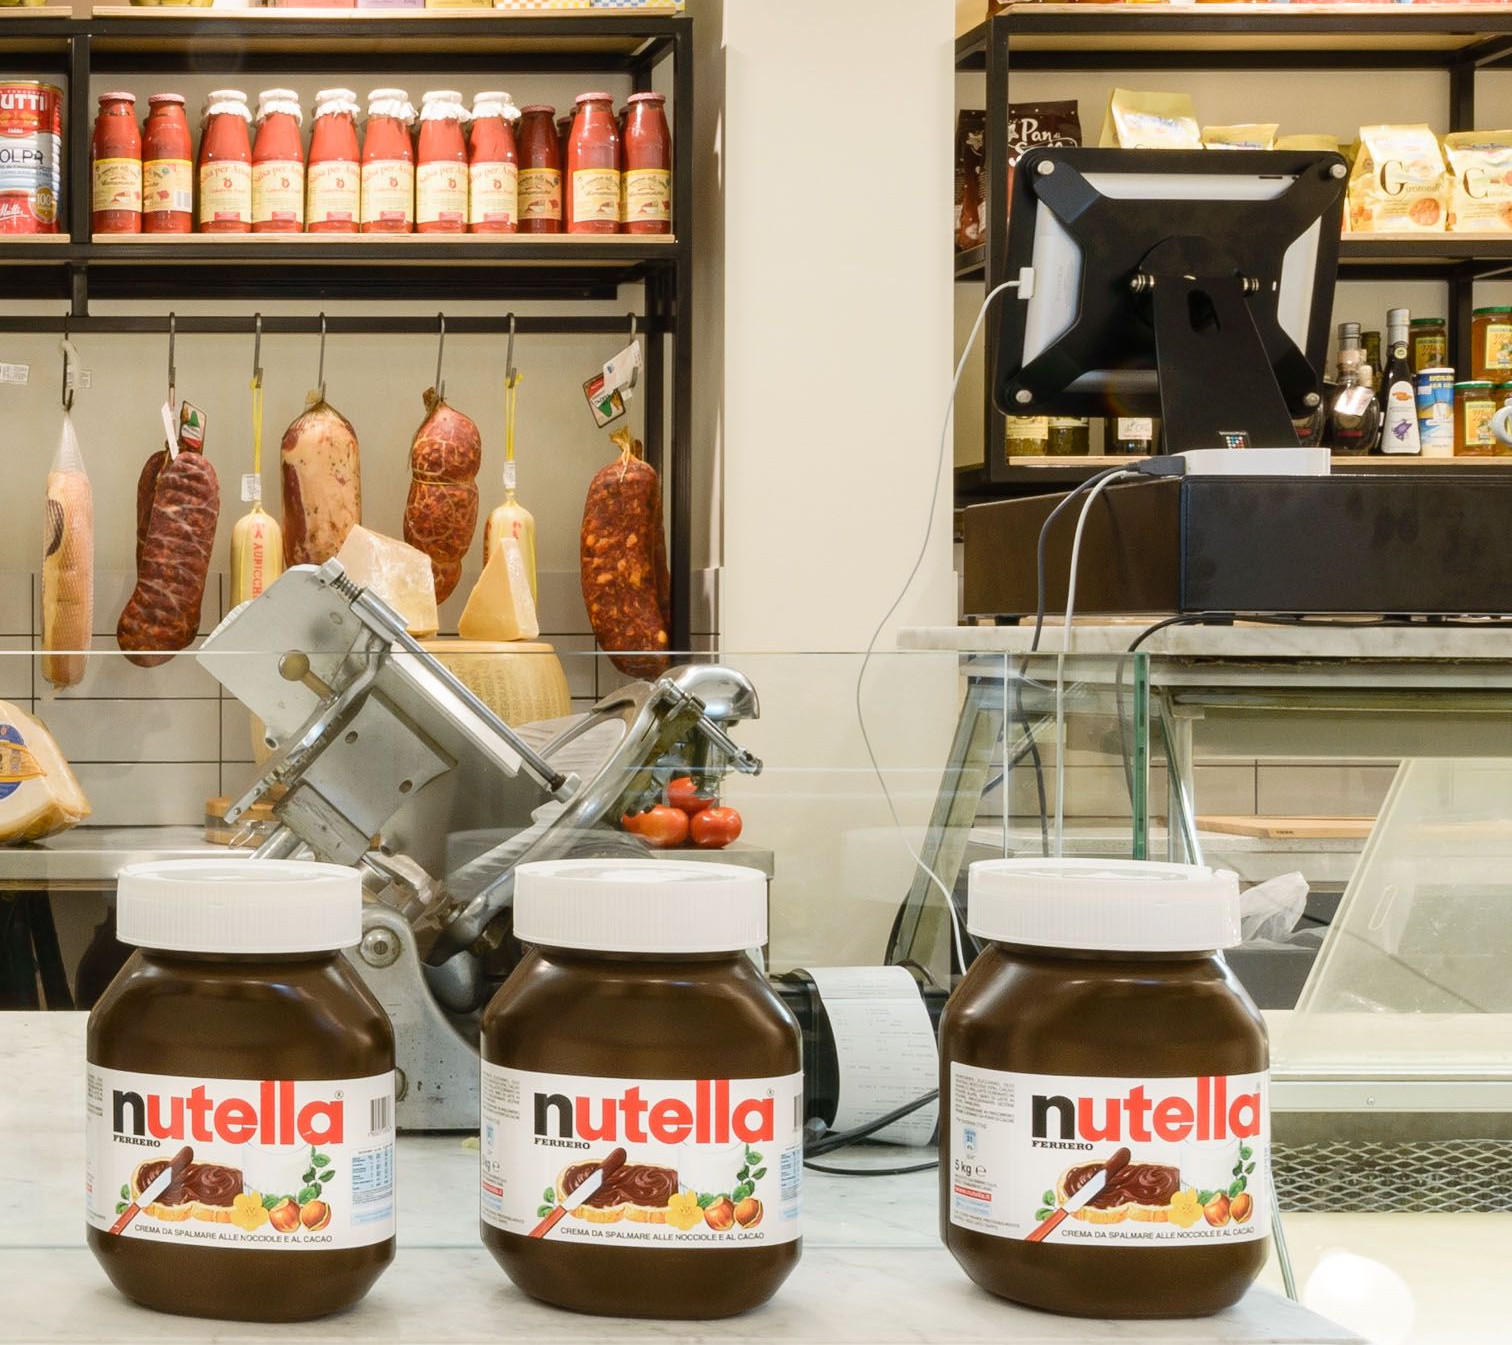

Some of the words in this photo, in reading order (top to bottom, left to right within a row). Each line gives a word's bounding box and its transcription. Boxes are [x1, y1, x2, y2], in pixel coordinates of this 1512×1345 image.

[113, 1080, 343, 1146] nutella
[534, 1080, 774, 1144] nutella
[1032, 1076, 1261, 1142] nutella
[113, 1136, 160, 1148] FERRERO
[534, 1138, 590, 1150] FERRERO
[1032, 1141, 1093, 1151] FERRERO
[135, 1224, 160, 1235] CREMA
[175, 1228, 216, 1240] SPALMARE
[218, 1232, 238, 1241] ALLE
[240, 1234, 282, 1242] NOCCIOLE
[303, 1234, 332, 1243] CACAO
[1061, 1229, 1092, 1238] CREMA
[1109, 1230, 1154, 1239] SPALMARE
[1156, 1231, 1175, 1239] ALLE
[1177, 1230, 1215, 1238] NOCCIOLE
[1216, 1229, 1222, 1237] E
[1233, 1227, 1255, 1236] CACAO
